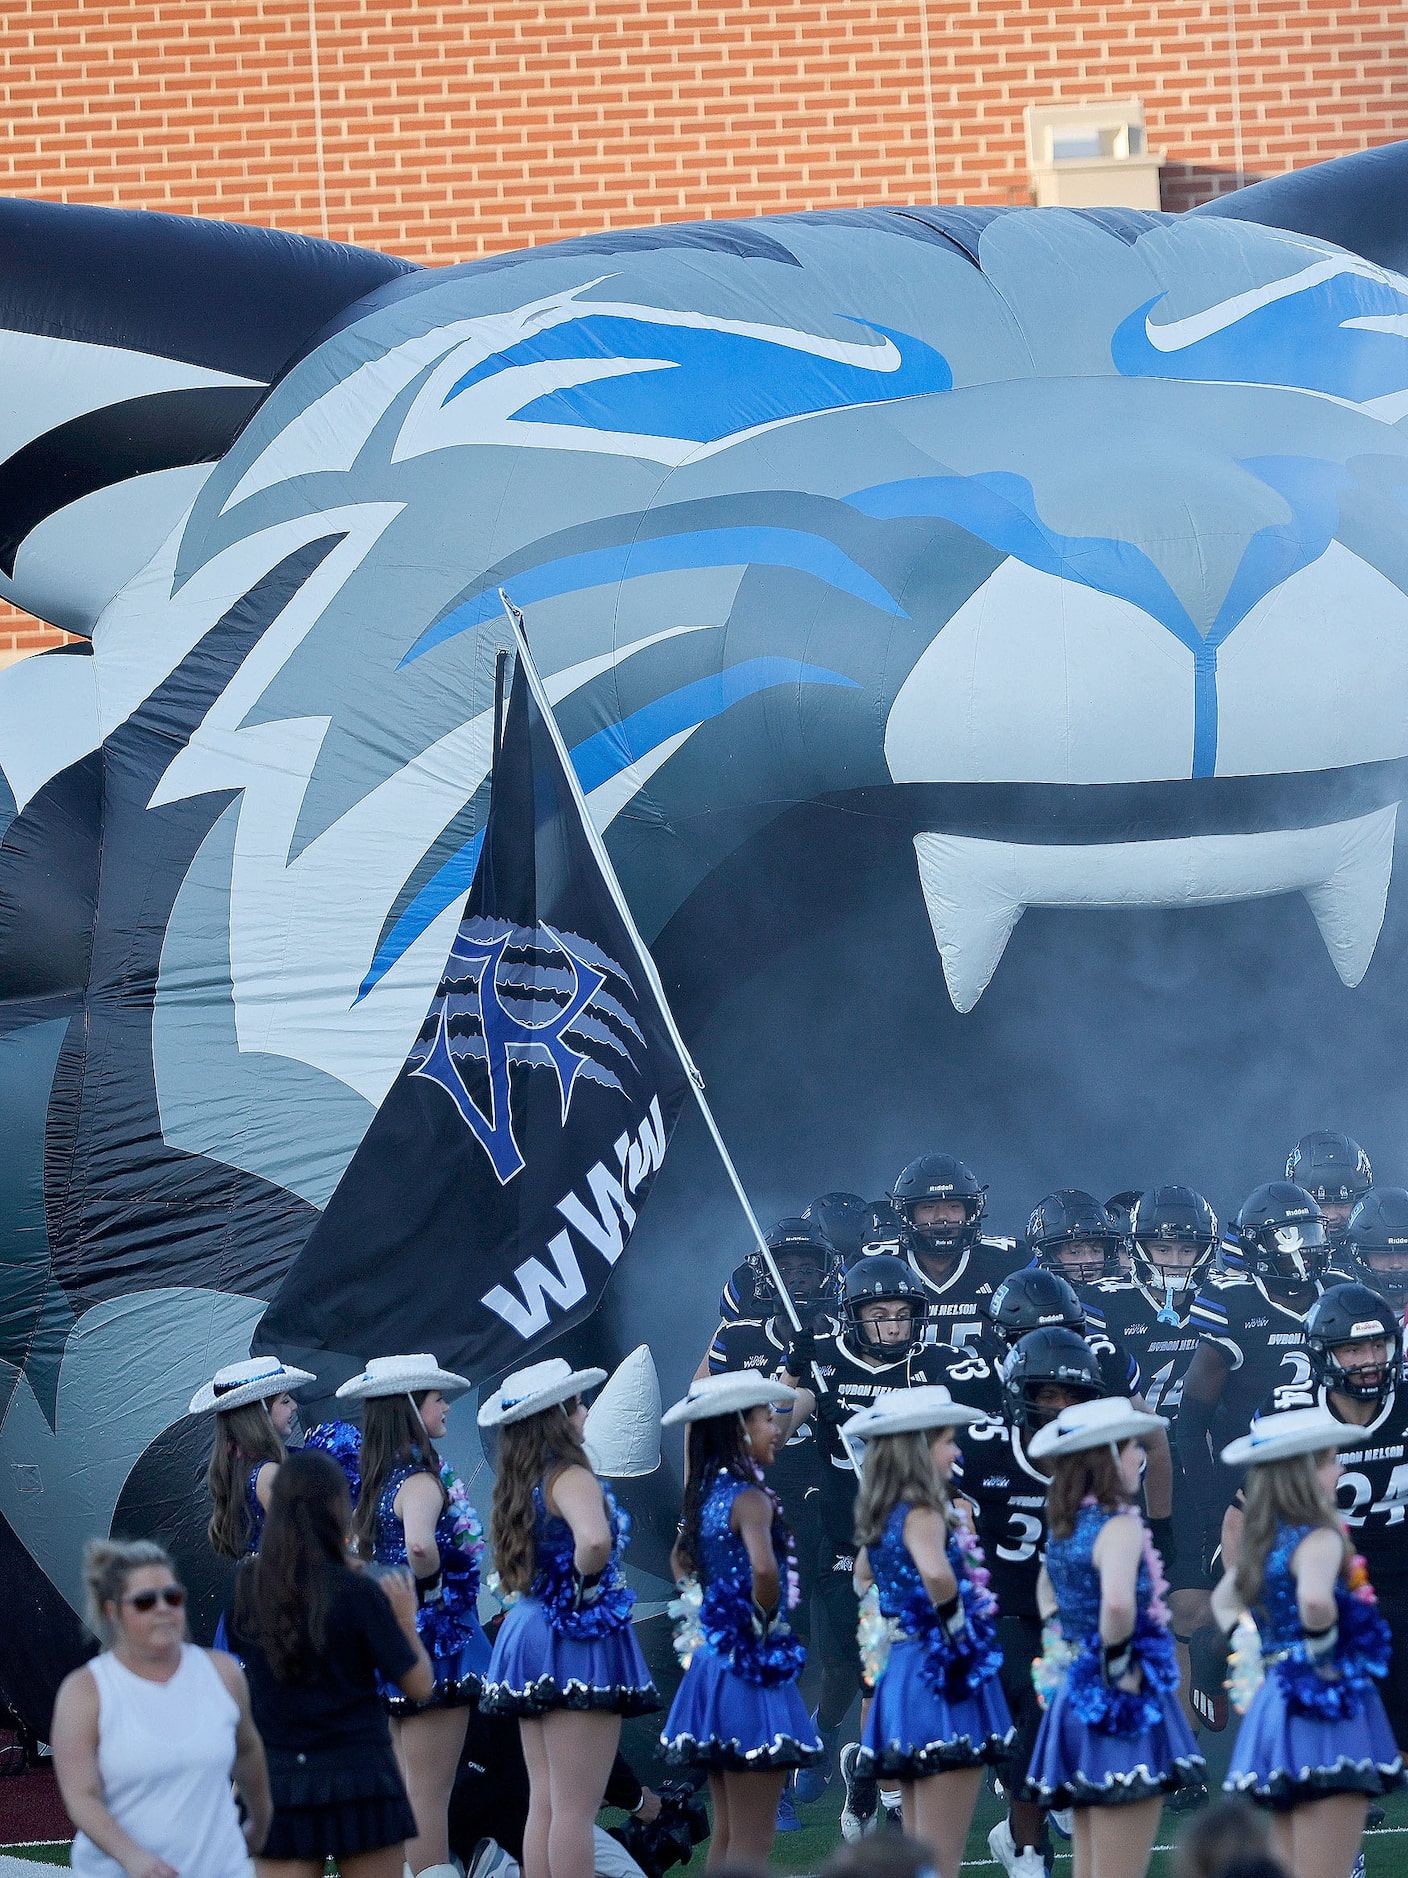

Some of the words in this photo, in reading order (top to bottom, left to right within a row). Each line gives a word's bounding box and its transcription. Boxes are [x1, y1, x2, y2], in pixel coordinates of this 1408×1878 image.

[1285, 1208, 1310, 1217] Riddell
[937, 1304, 977, 1316] NELSON
[1267, 1333, 1300, 1345] BYRON
[1364, 1445, 1404, 1461] NELSON
[996, 1512, 1046, 1562] 3
